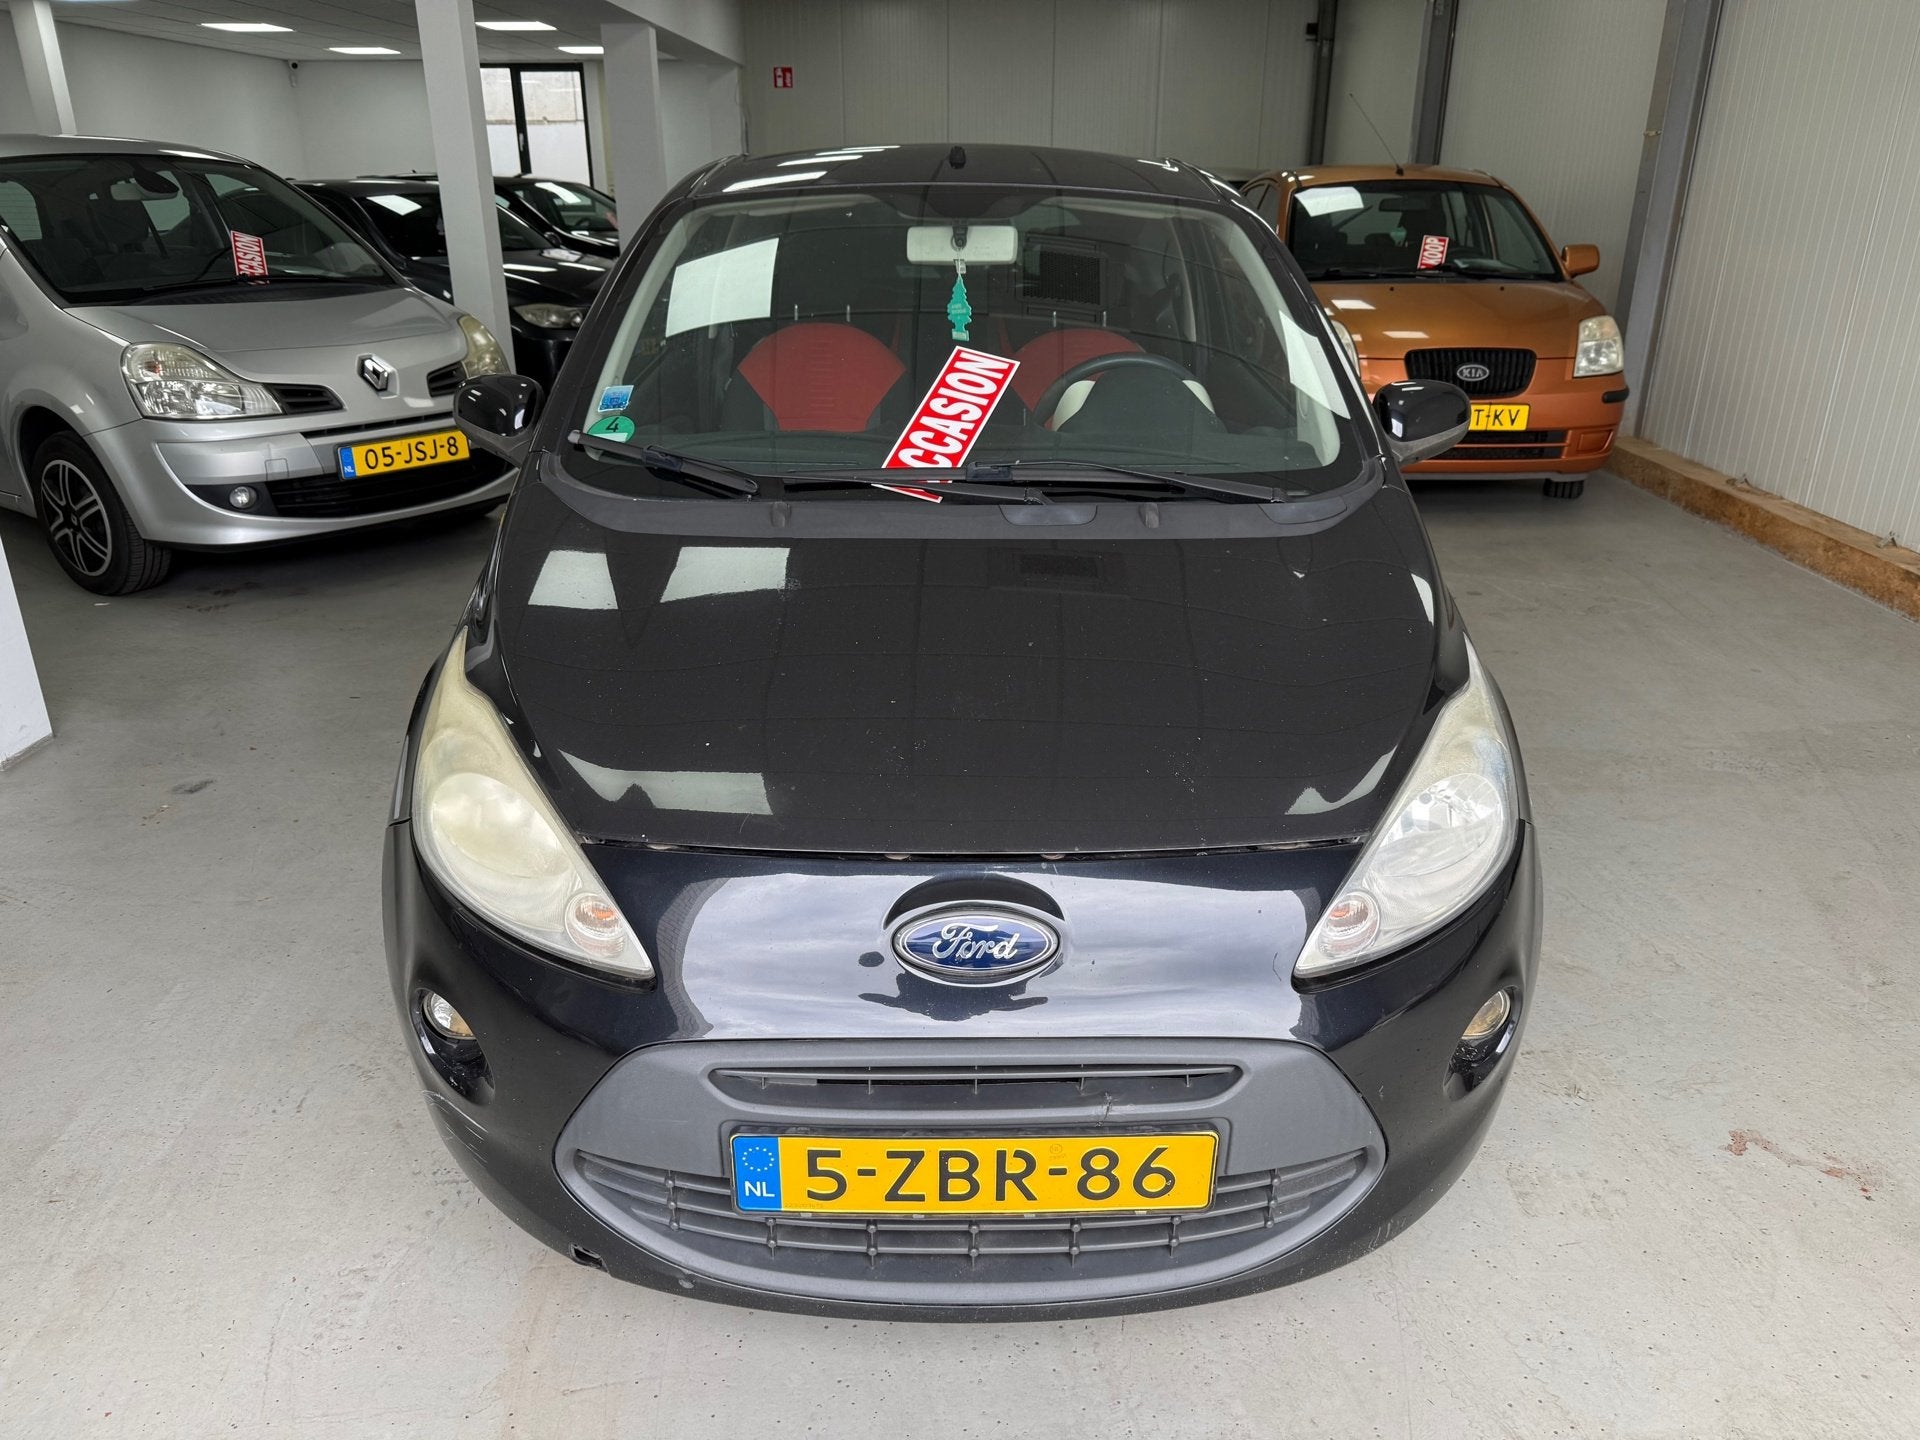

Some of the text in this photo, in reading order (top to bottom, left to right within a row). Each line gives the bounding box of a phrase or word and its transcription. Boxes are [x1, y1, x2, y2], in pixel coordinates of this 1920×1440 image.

[234, 232, 265, 277] CASION
[1462, 368, 1484, 378] KIA
[896, 351, 1011, 470] CCASION
[1473, 409, 1520, 426] T-KV
[605, 416, 620, 433] 4
[364, 436, 459, 470] 05-JSJ-8
[344, 465, 355, 473] NL
[932, 922, 1021, 959] Ford
[807, 1147, 1176, 1202] 5-ZBR-86
[744, 1180, 775, 1197] NL
